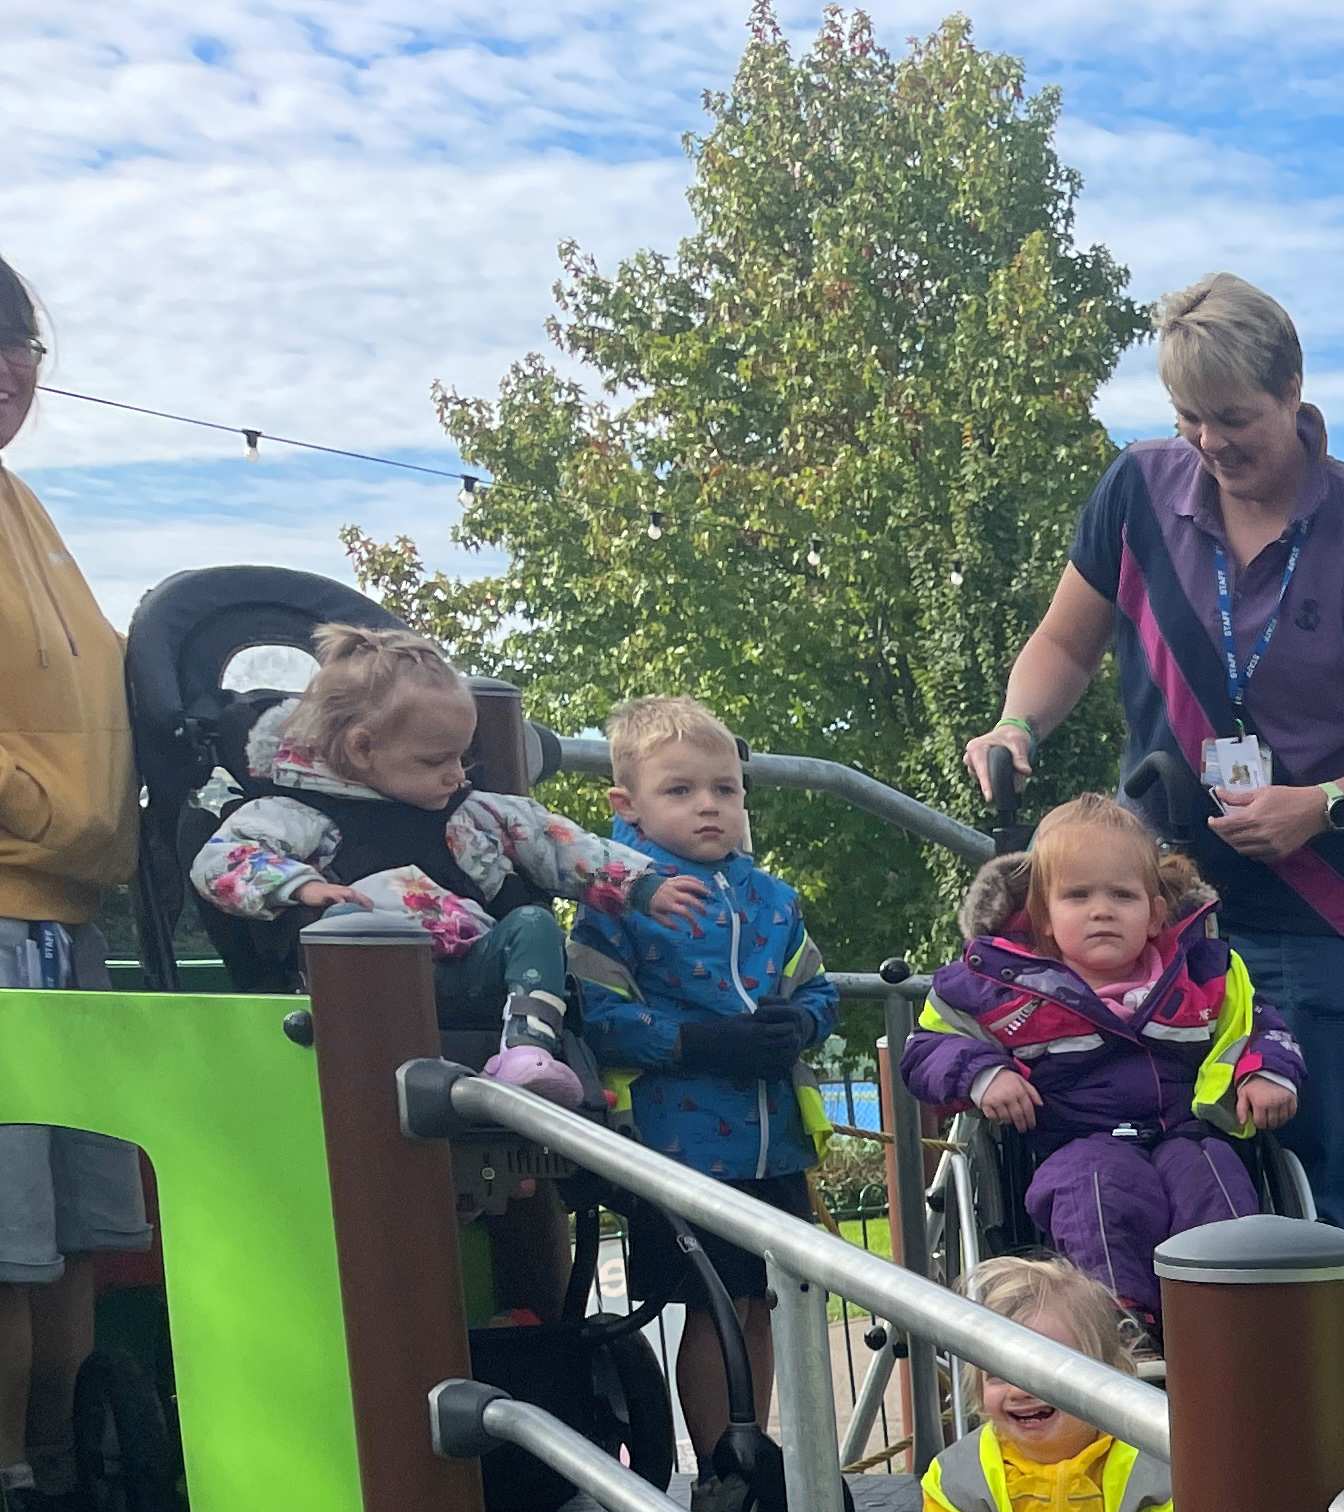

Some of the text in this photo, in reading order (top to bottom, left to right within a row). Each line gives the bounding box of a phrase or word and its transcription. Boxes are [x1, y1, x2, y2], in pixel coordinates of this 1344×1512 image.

[1217, 570, 1228, 596] STAFF
[1221, 610, 1232, 636] STAFF
[1227, 652, 1238, 679] STAFF
[44, 929, 55, 959] STAFF
